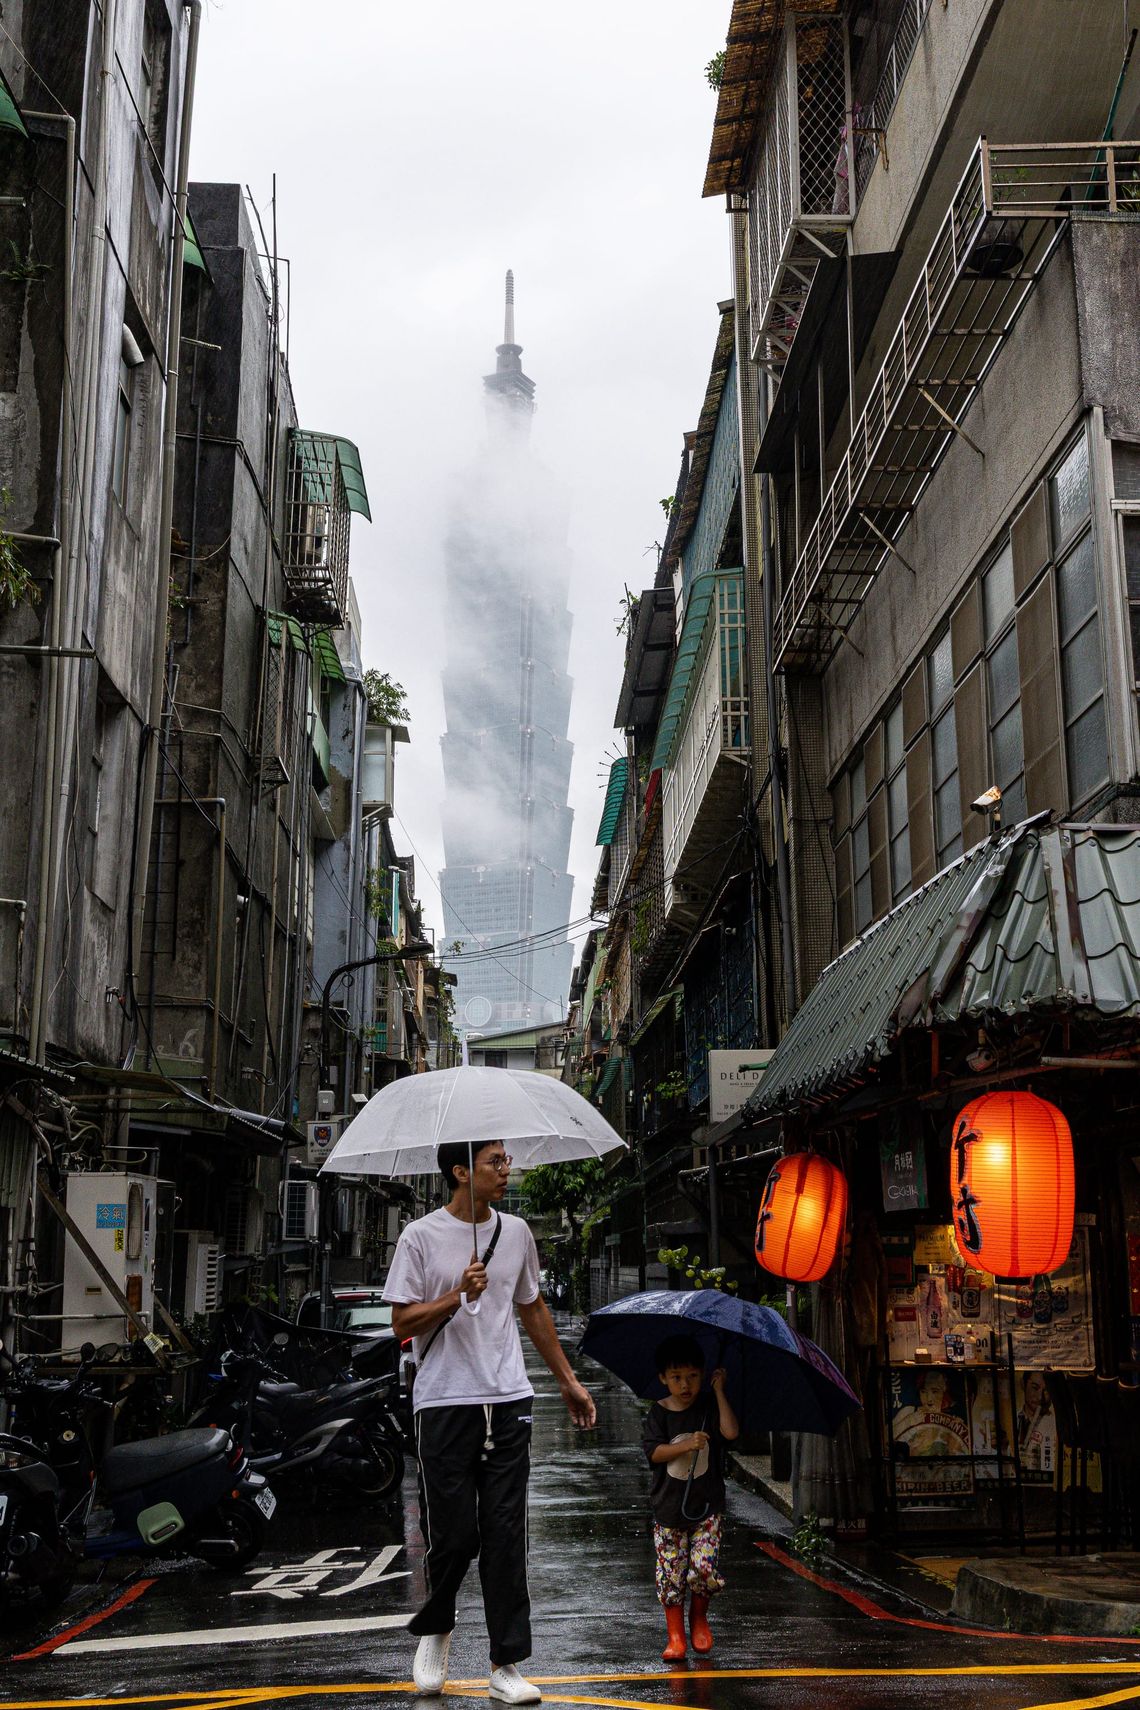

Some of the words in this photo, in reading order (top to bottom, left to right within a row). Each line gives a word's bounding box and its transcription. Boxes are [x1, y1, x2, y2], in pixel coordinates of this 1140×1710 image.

[720, 1072, 746, 1080] DELI
[97, 1206, 124, 1220] 冷氣
[929, 1413, 967, 1435] COMPANY
